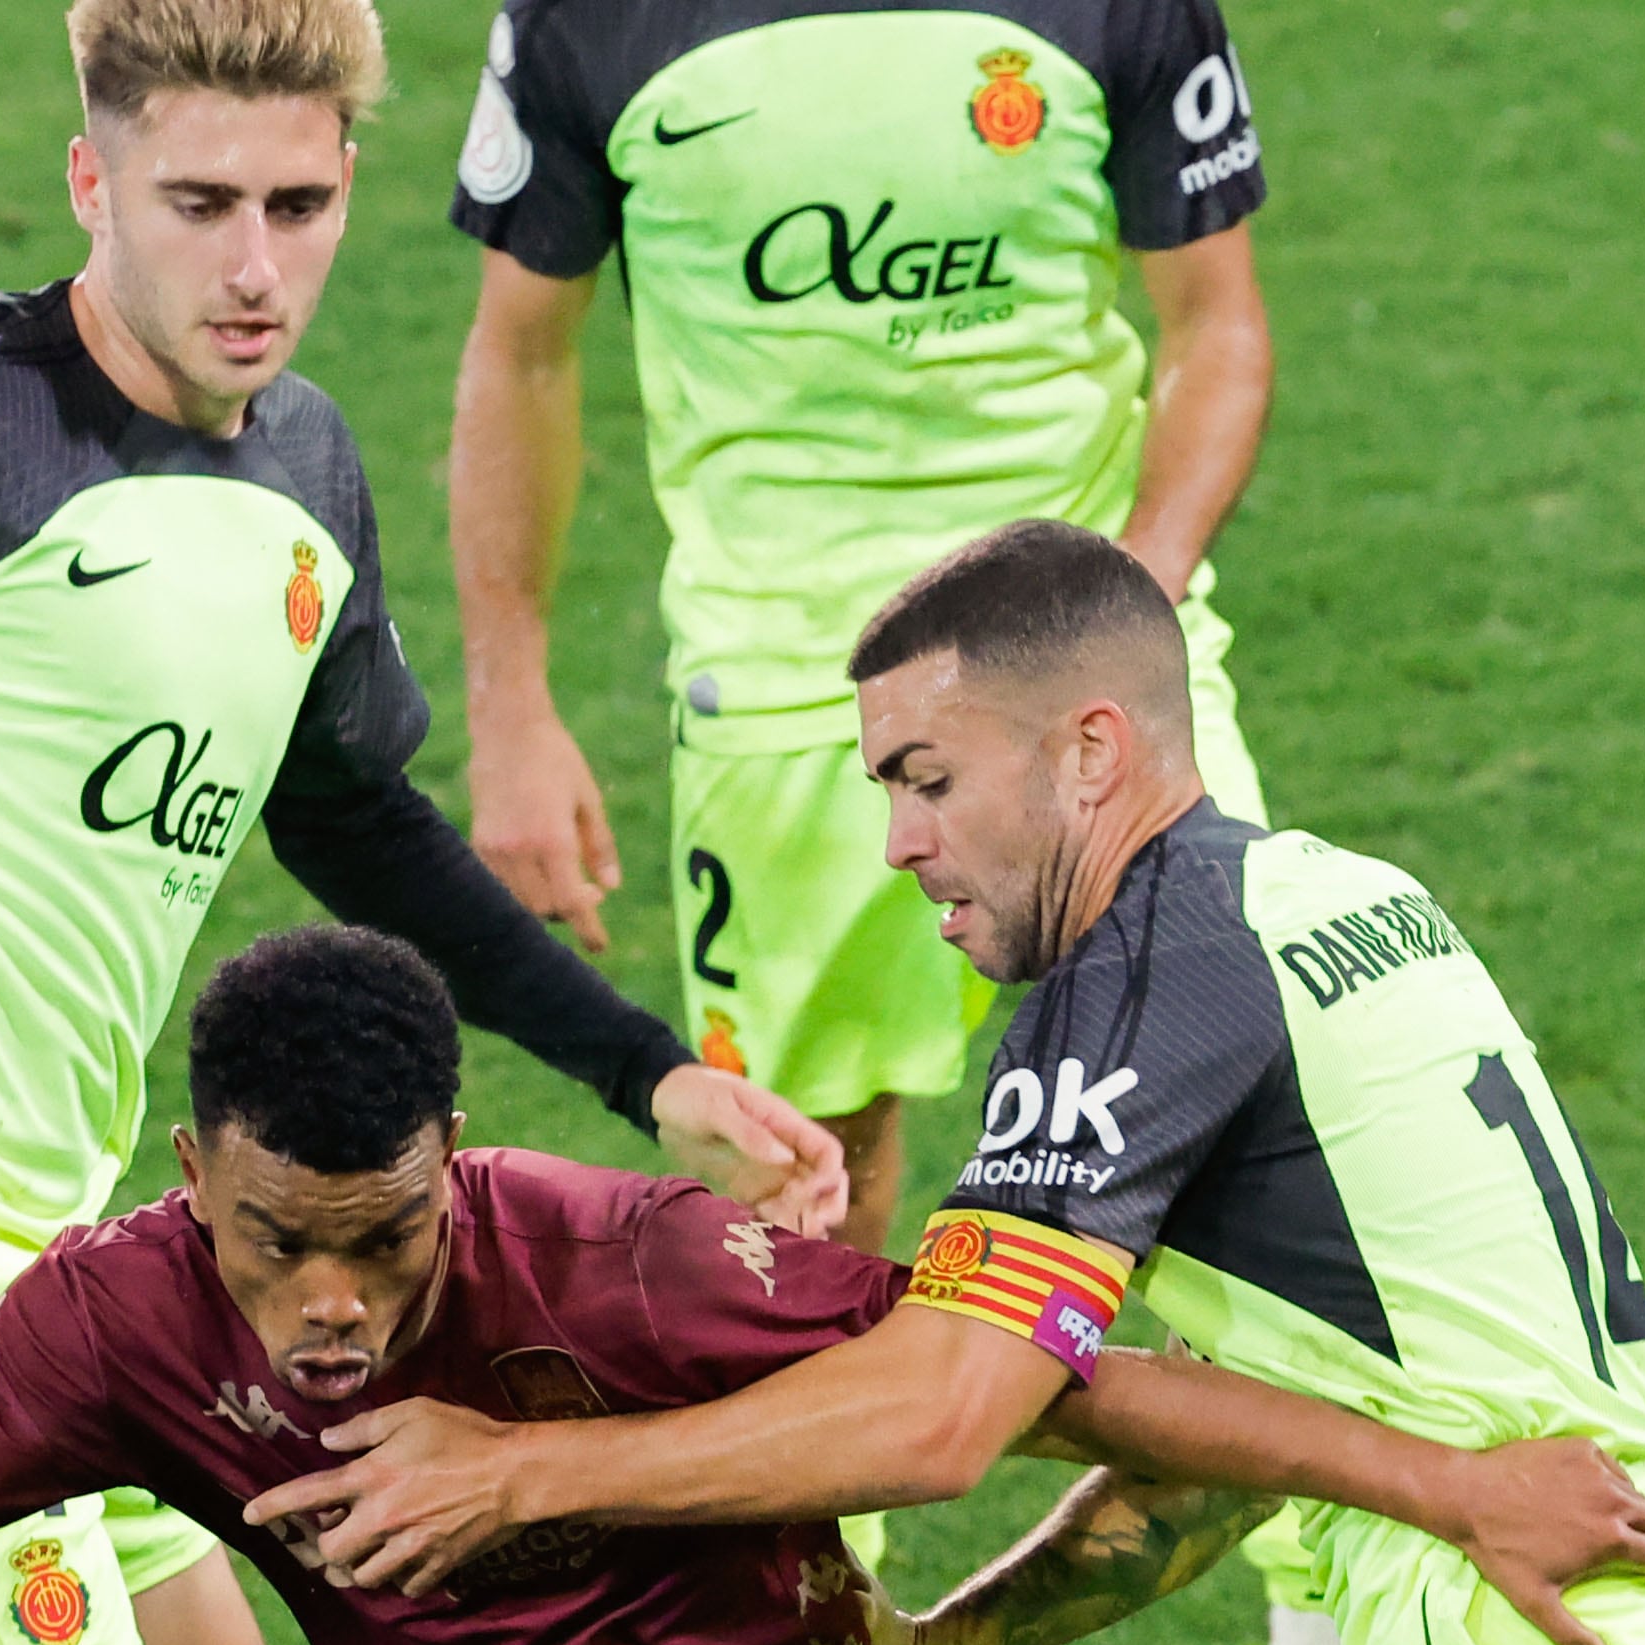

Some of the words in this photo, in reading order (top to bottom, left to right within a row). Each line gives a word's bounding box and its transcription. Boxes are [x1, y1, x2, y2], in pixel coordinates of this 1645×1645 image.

[689, 847, 736, 989] 2
[1277, 912, 1408, 1010] DANI
[978, 1057, 1139, 1156] OK
[957, 1149, 1116, 1194] mobility
